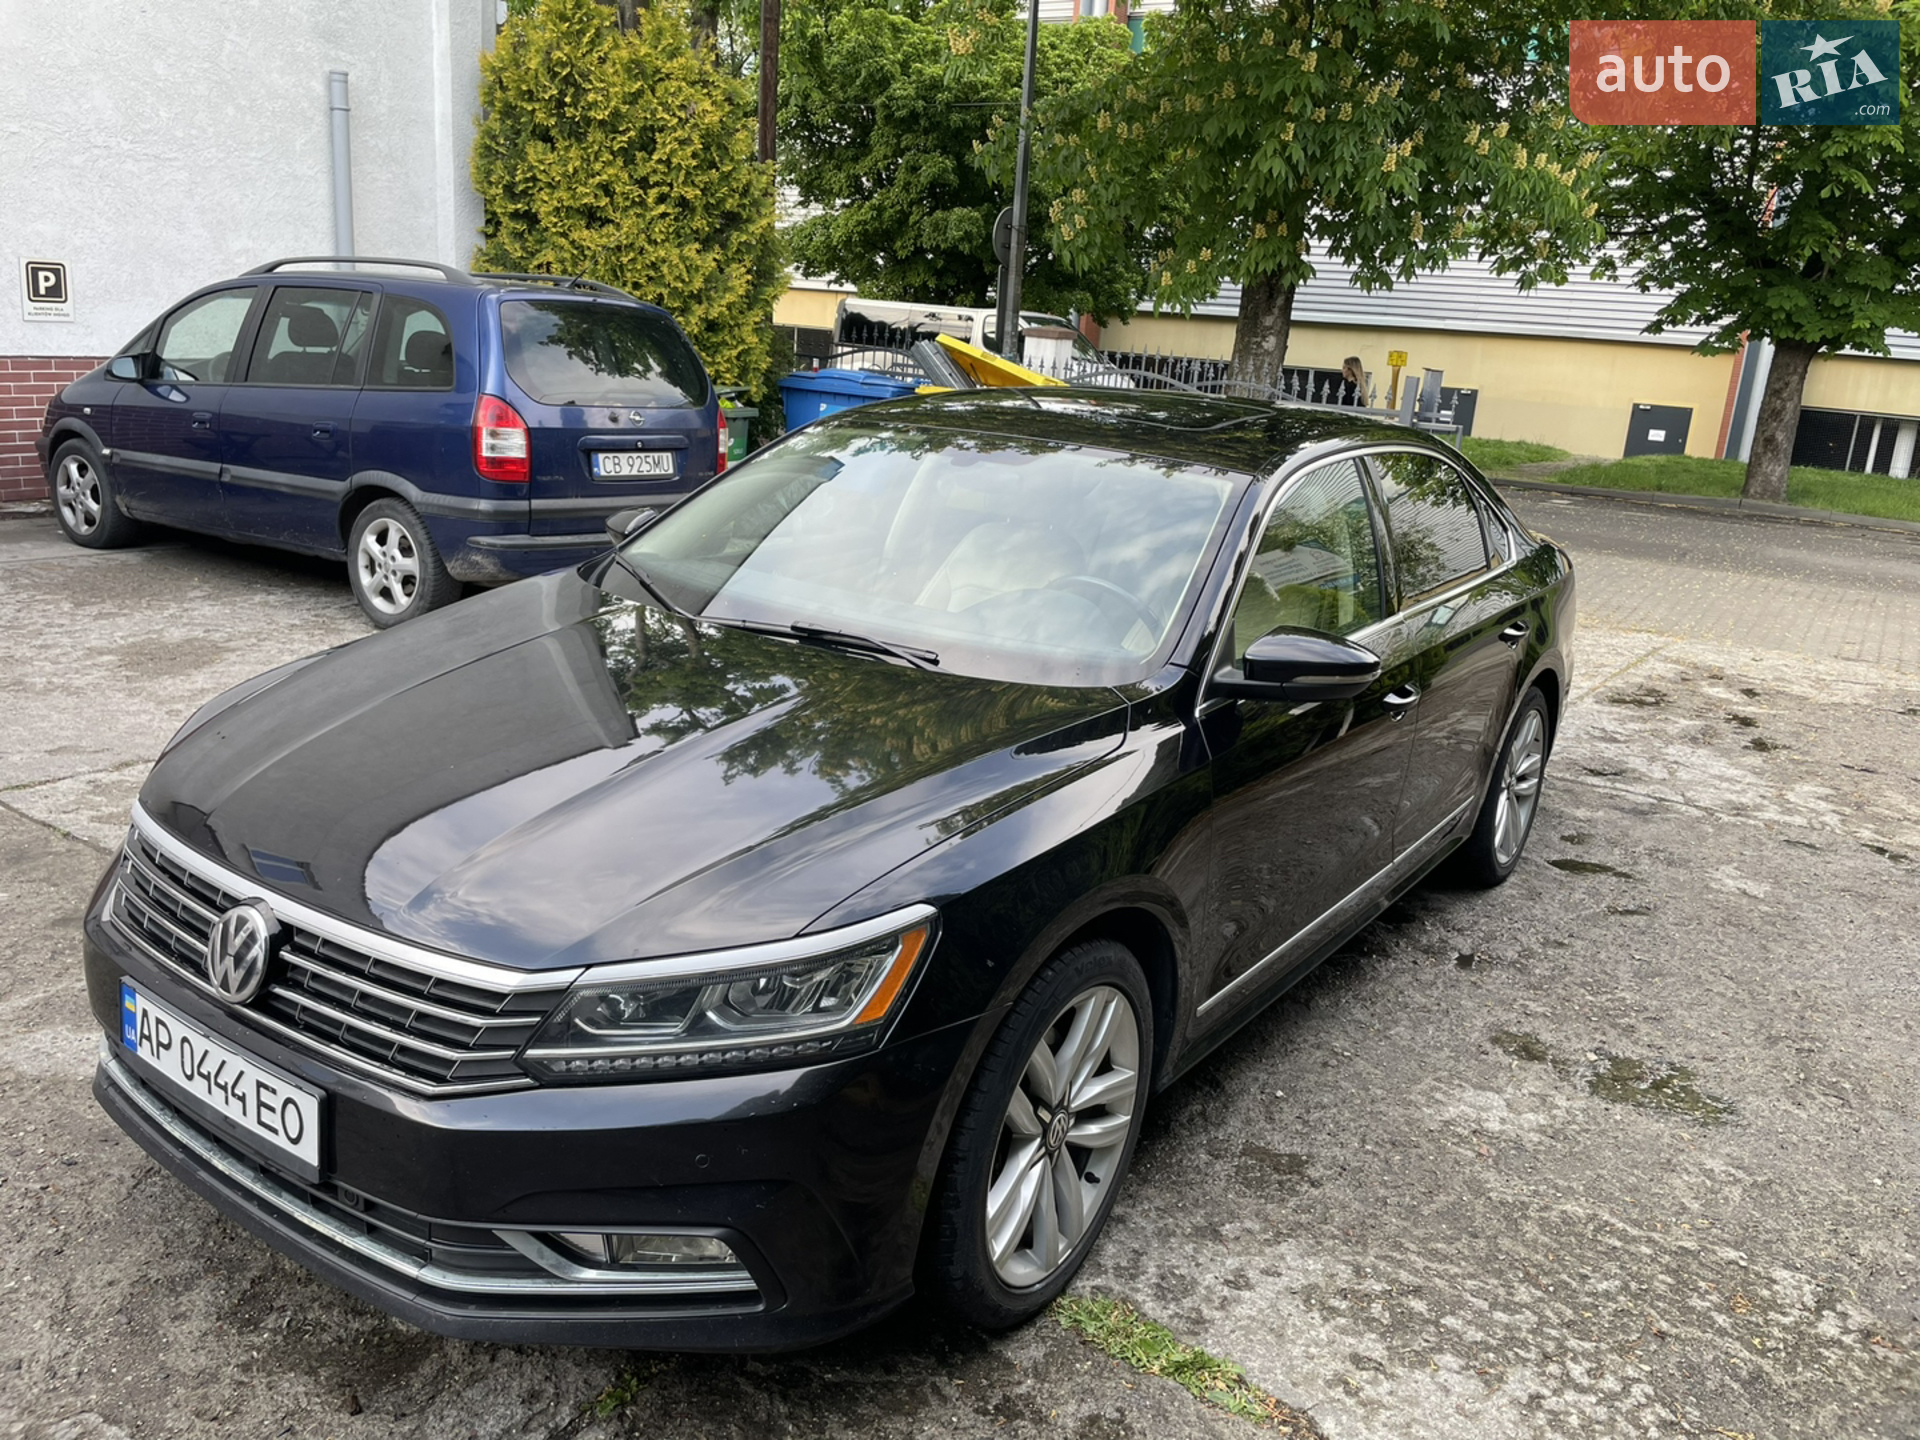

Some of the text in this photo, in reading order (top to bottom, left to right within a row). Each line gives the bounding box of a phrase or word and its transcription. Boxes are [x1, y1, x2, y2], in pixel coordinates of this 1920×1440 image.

[38, 271, 56, 295] P
[602, 454, 671, 474] CB 925MU
[125, 1024, 137, 1044] UA
[139, 1007, 305, 1146] AP 0444 EO
